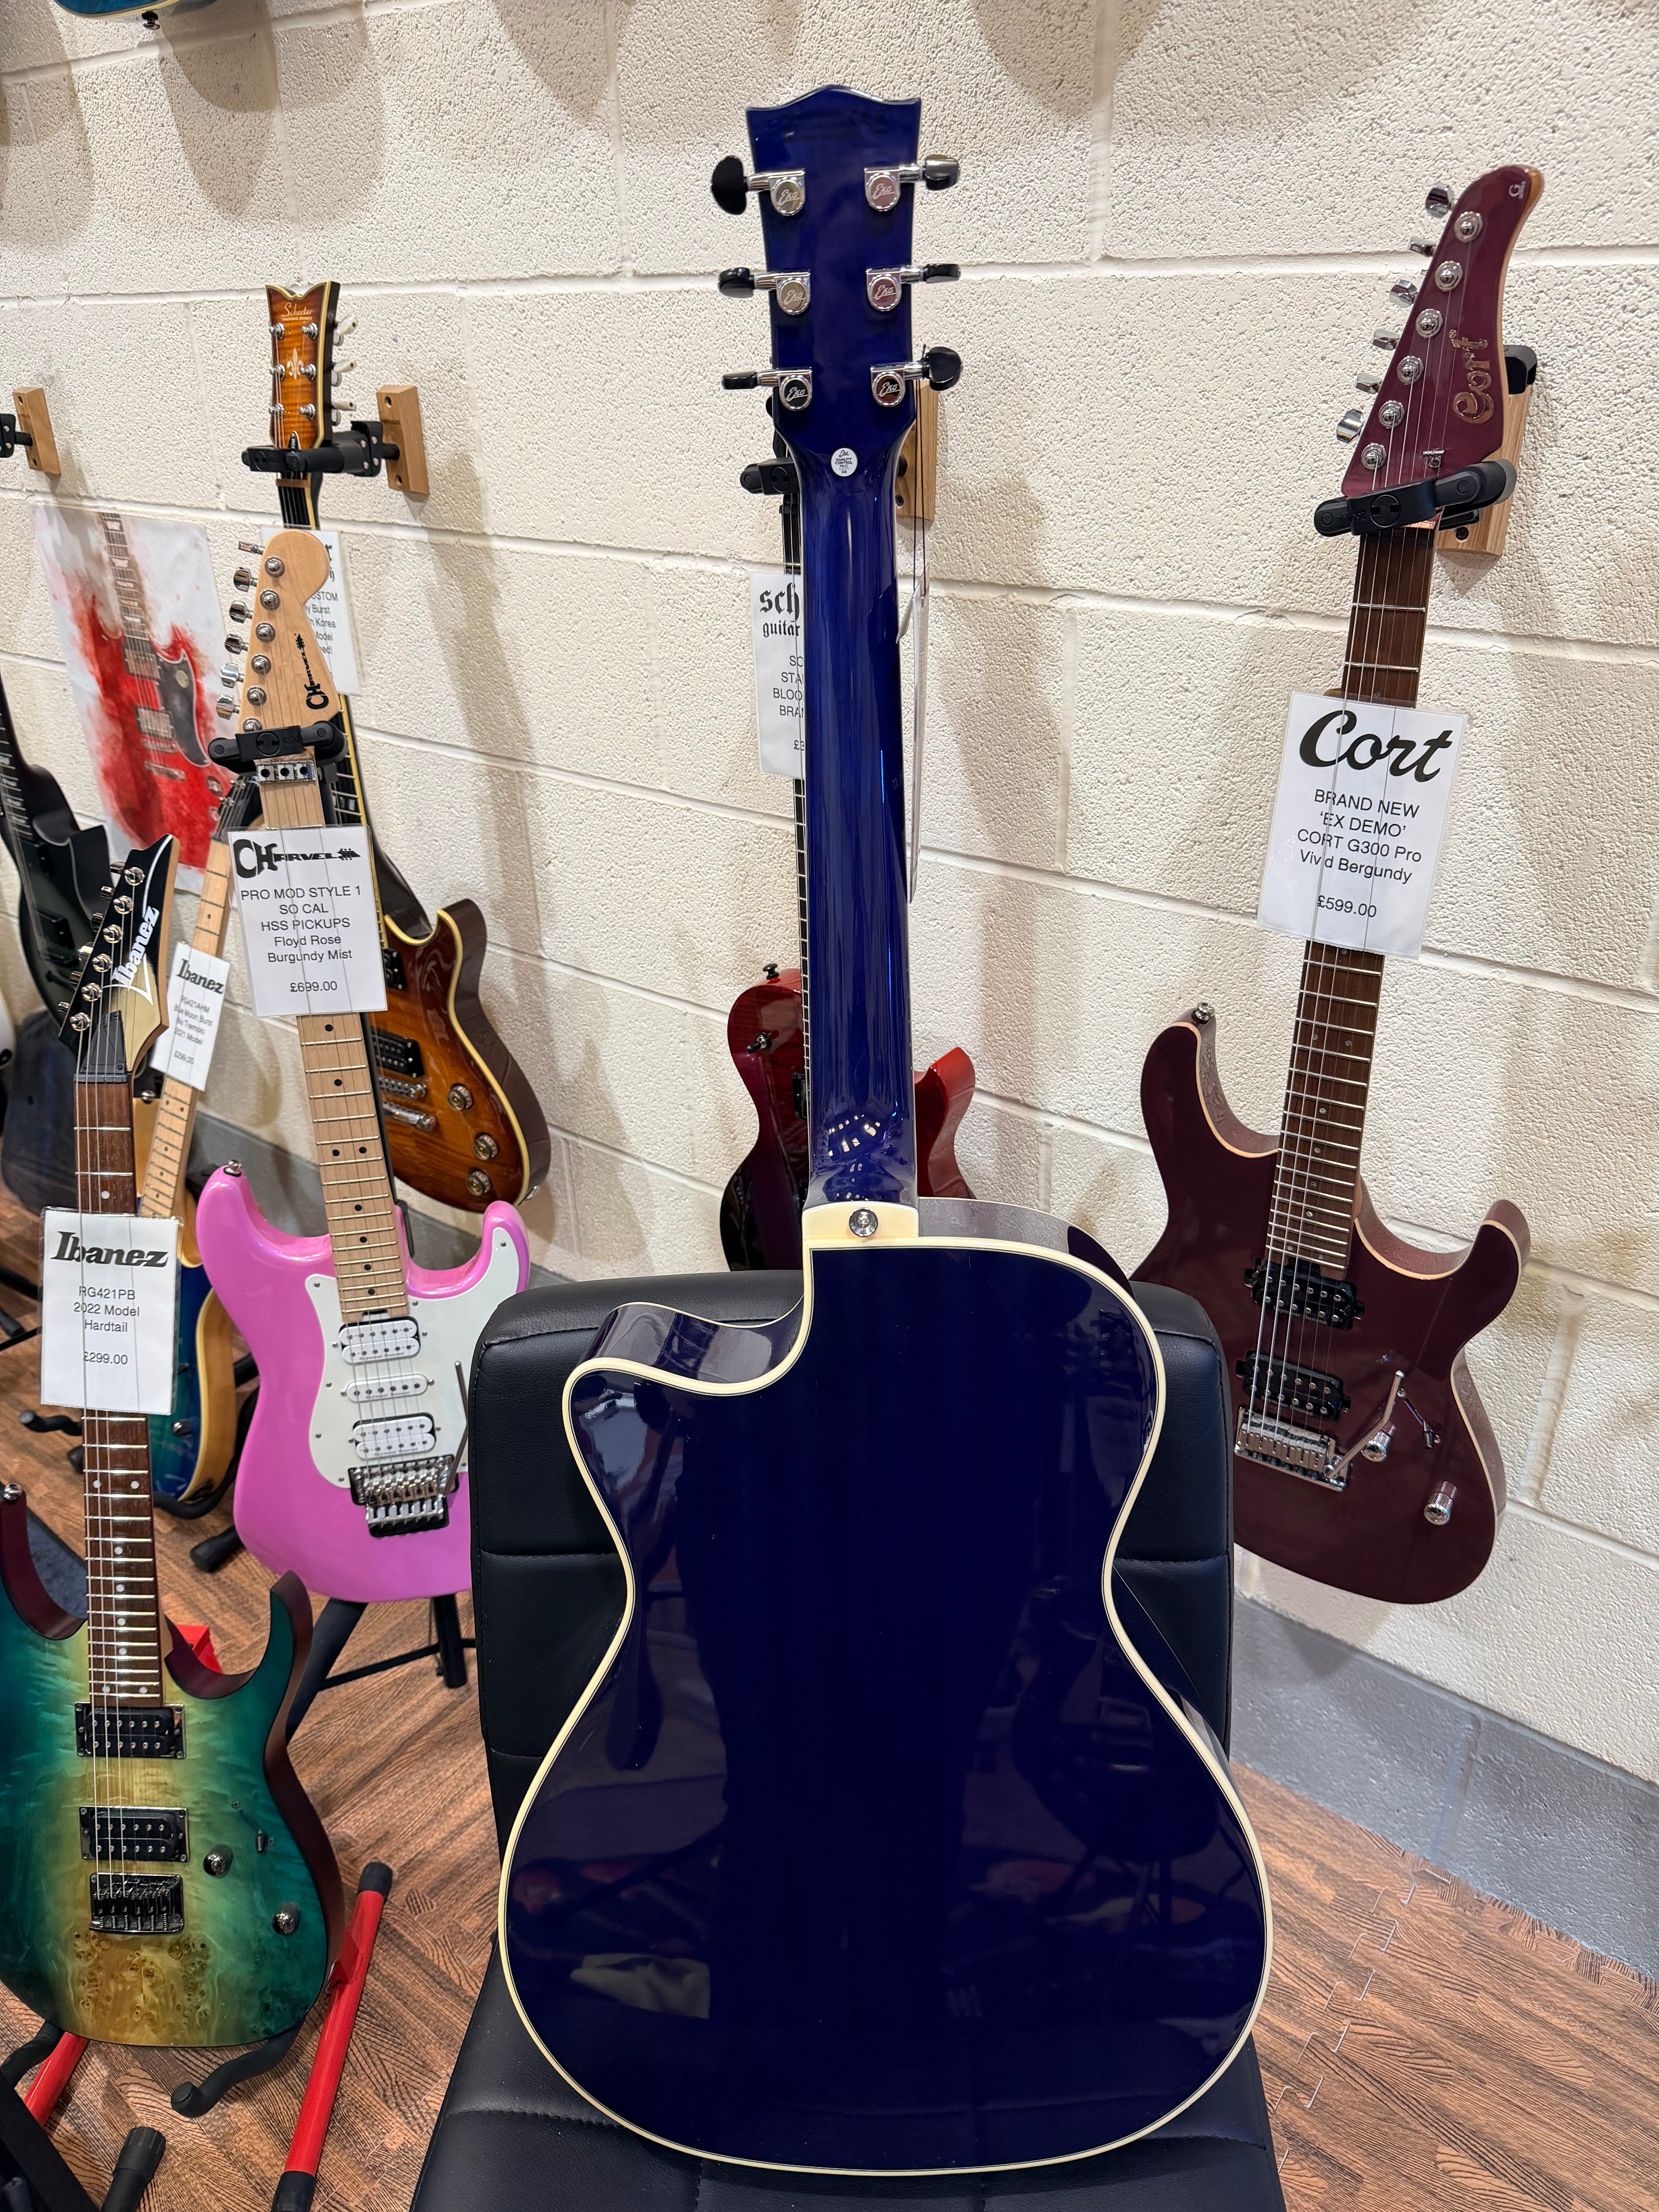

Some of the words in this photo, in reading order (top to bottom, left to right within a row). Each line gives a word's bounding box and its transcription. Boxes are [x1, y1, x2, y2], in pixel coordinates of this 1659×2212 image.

[778, 189, 800, 206] Eko
[872, 183, 894, 199] Eko
[783, 290, 805, 305] Eko
[872, 285, 896, 300] Eko
[282, 302, 313, 317] Schecter
[1451, 338, 1494, 424] Cort
[785, 387, 808, 402] Eko
[877, 382, 900, 397] Eko
[312, 604, 330, 614] Burst
[315, 618, 337, 628] Korea
[781, 672, 803, 684] STA
[773, 688, 803, 701] BLOO
[1299, 710, 1453, 783] Cort
[1314, 789, 1372, 811] BRAND
[1377, 800, 1420, 818] NEW
[1297, 829, 1343, 849] CORT
[1347, 839, 1390, 857] G300
[1394, 845, 1422, 862] Pro
[1300, 849, 1334, 869] Vivd
[1338, 855, 1413, 885] Bergundy
[241, 889, 270, 900] PRO
[274, 888, 305, 899] MOD
[309, 886, 351, 898] STYLE
[355, 885, 361, 895] 1
[279, 904, 299, 915] SO
[302, 903, 329, 914] CAL
[1317, 895, 1377, 918] £599.00
[261, 920, 289, 932] HSS
[293, 917, 350, 931] PICKUPS
[112, 906, 160, 987] Ibanez
[274, 936, 306, 948] Floyd
[311, 935, 341, 946] Rose
[268, 951, 324, 964] Burgundy
[328, 949, 353, 960] Mist
[176, 958, 225, 994] Ibanez
[290, 980, 338, 993] £699.00
[51, 1231, 169, 1268] Ibanez
[79, 1286, 136, 1300] RG421PB
[74, 1302, 101, 1314] 2022
[104, 1305, 139, 1317] Model
[84, 1319, 128, 1332] Hardtail
[1304, 1314, 1327, 1324] Duncan
[84, 1351, 128, 1365] £299.00
[1290, 1405, 1313, 1416] Duncan
